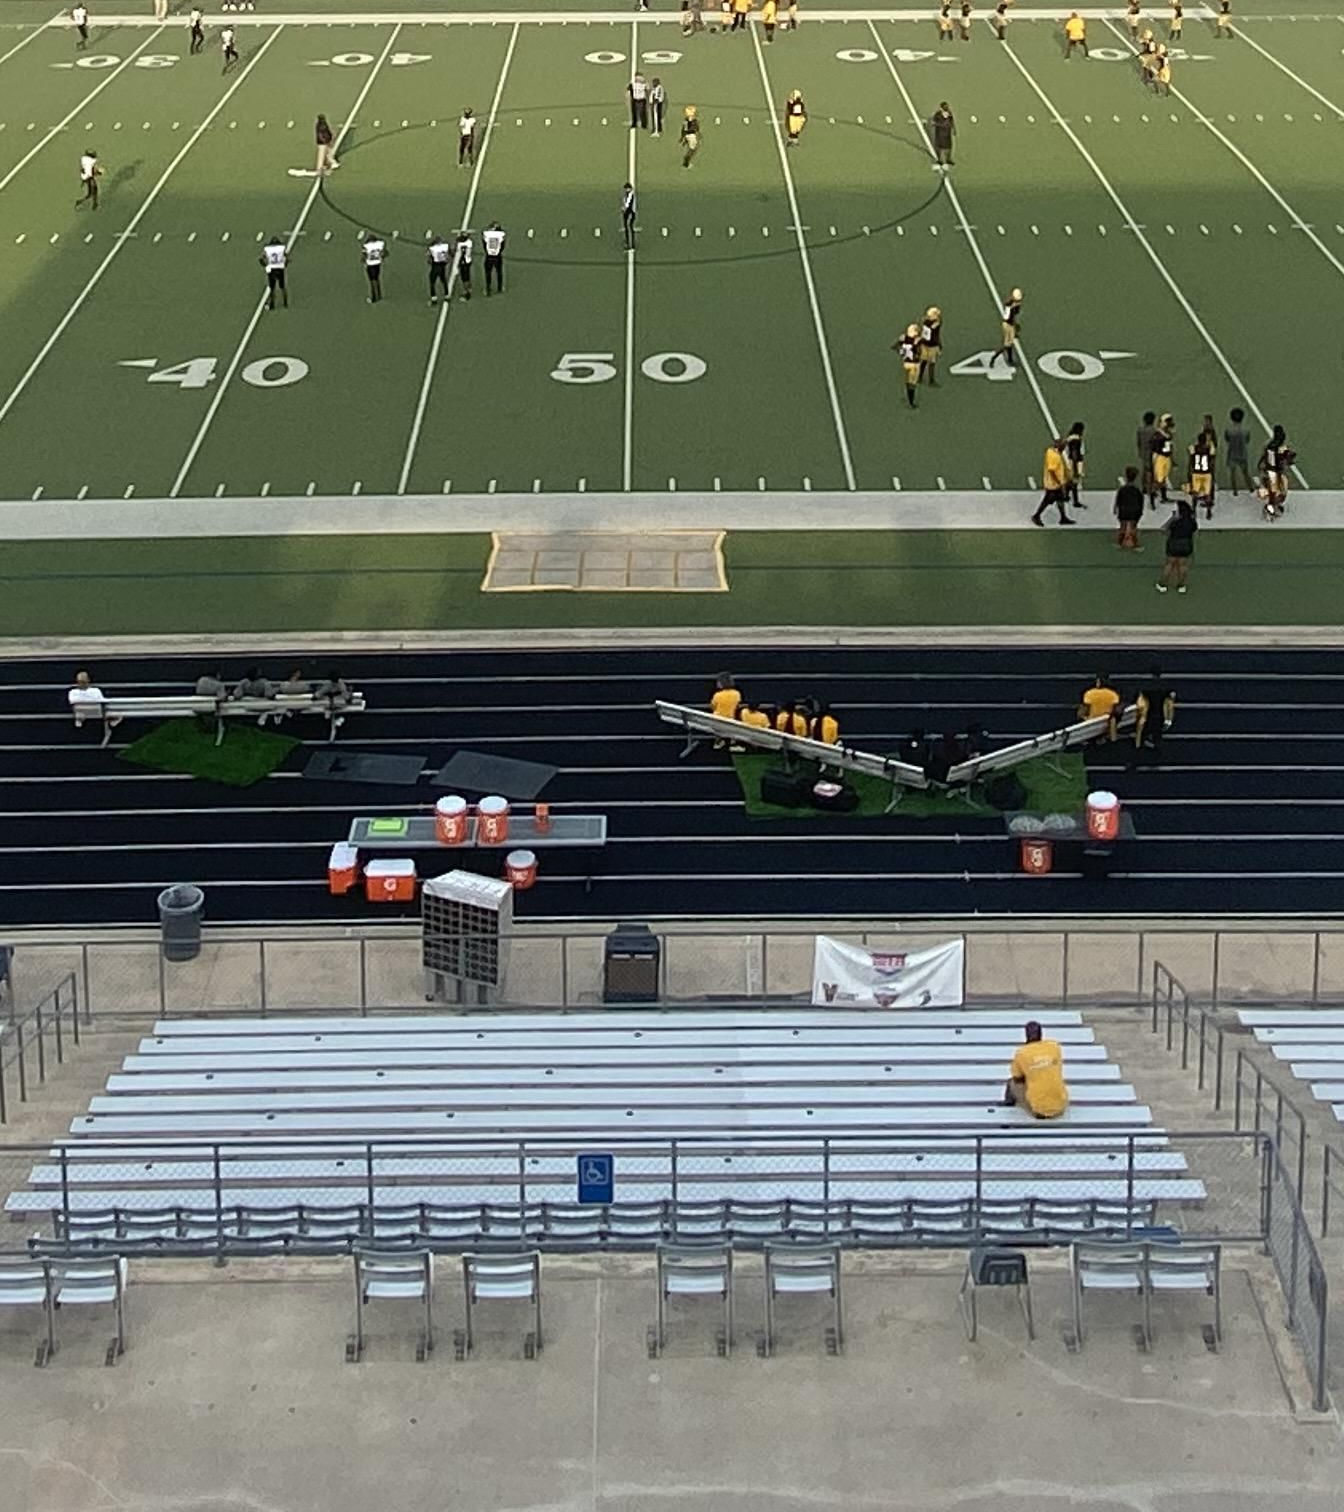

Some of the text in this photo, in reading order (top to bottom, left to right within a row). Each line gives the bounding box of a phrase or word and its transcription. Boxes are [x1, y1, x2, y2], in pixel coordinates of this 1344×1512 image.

[76, 54, 181, 68] 30
[331, 52, 433, 66] 40
[584, 50, 683, 64] 50
[835, 48, 936, 62] 40
[146, 356, 310, 388] 40
[550, 352, 708, 384] 50
[948, 350, 1105, 381] 40
